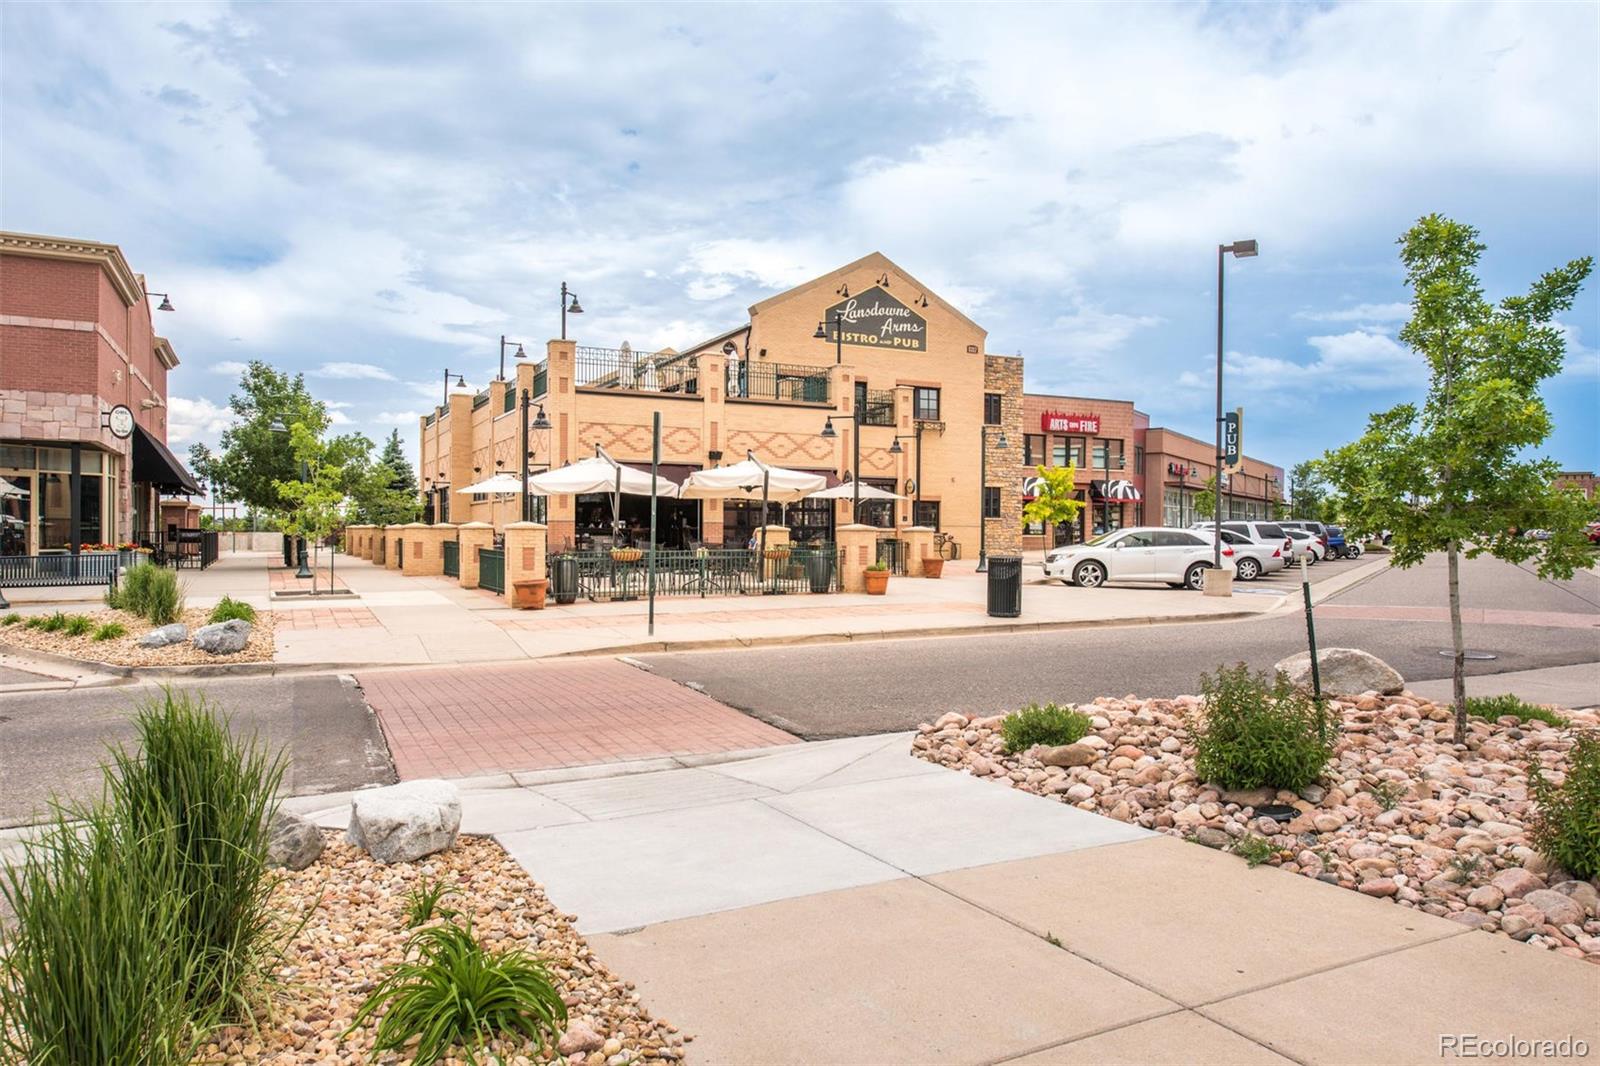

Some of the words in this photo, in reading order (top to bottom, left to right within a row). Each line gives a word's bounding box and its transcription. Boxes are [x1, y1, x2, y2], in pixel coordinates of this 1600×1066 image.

[835, 299, 911, 324] Lansdowne
[881, 318, 924, 337] Arms
[893, 337, 919, 348] PUB
[1050, 418, 1068, 431] ARTS
[1080, 420, 1098, 433] FIRE
[1227, 422, 1237, 456] PUB
